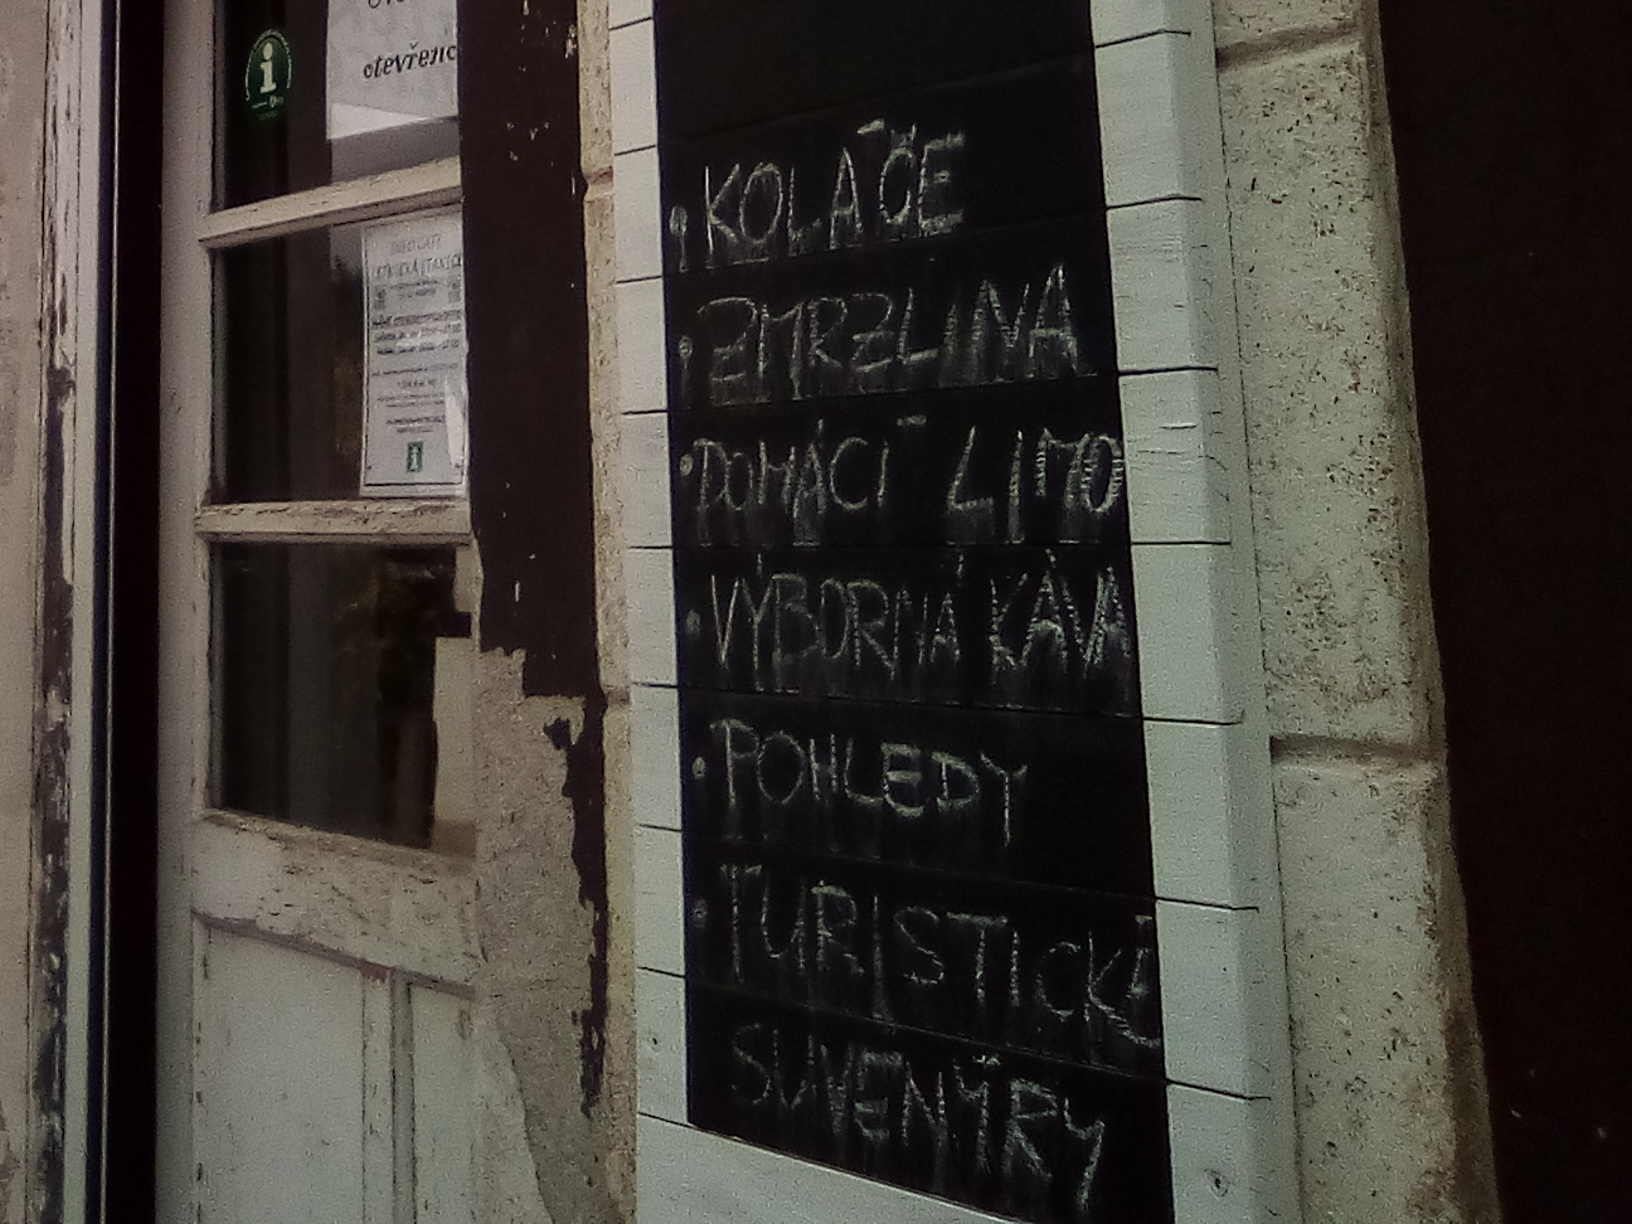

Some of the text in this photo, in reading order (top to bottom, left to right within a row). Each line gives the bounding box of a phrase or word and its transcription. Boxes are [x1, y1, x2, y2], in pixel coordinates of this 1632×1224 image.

[695, 262, 1082, 398] ZMRZLINA
[947, 425, 1125, 518] LIMO
[710, 547, 1133, 689] VÝBORNÁ KÁVA
[709, 718, 1029, 848] POHLEDY
[731, 1022, 1108, 1214] SUVENÝRY
